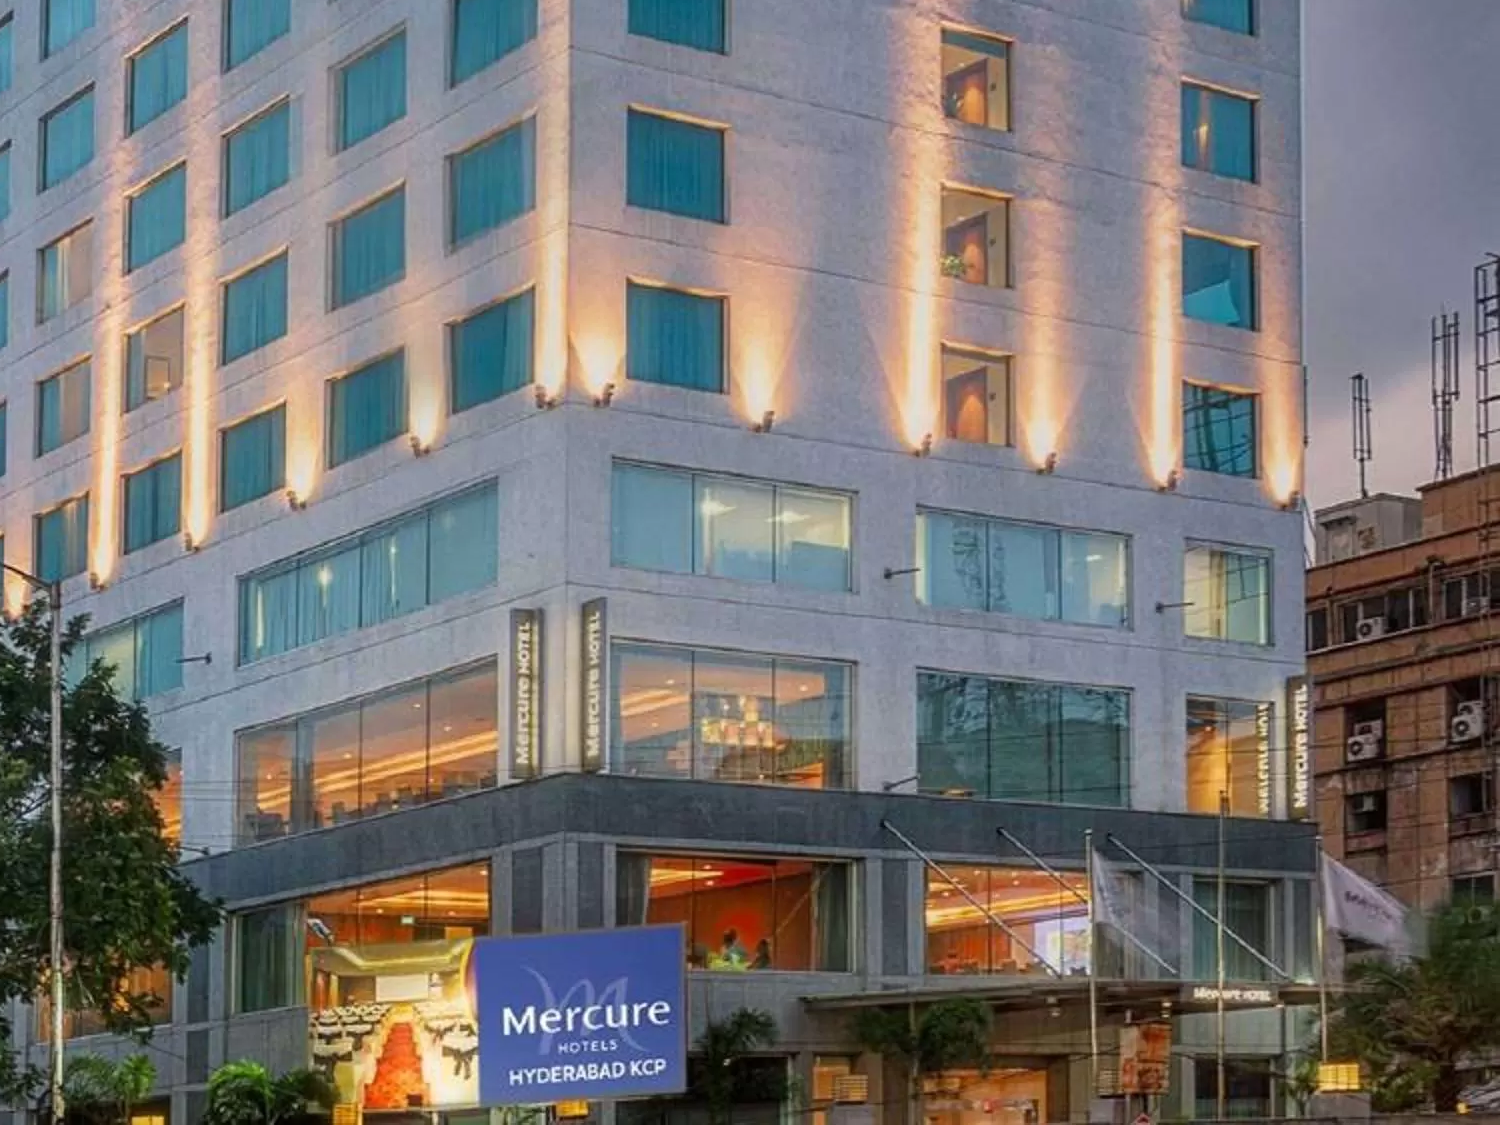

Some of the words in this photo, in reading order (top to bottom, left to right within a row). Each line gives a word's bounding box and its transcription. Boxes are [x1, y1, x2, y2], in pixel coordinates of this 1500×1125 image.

[517, 621, 531, 674] HOTEL
[516, 676, 530, 765] Mercure
[502, 999, 671, 1036] Mercure
[557, 1039, 618, 1054] HOTELS
[508, 1062, 626, 1086] HYDERABAD
[631, 1058, 667, 1076] KCP
